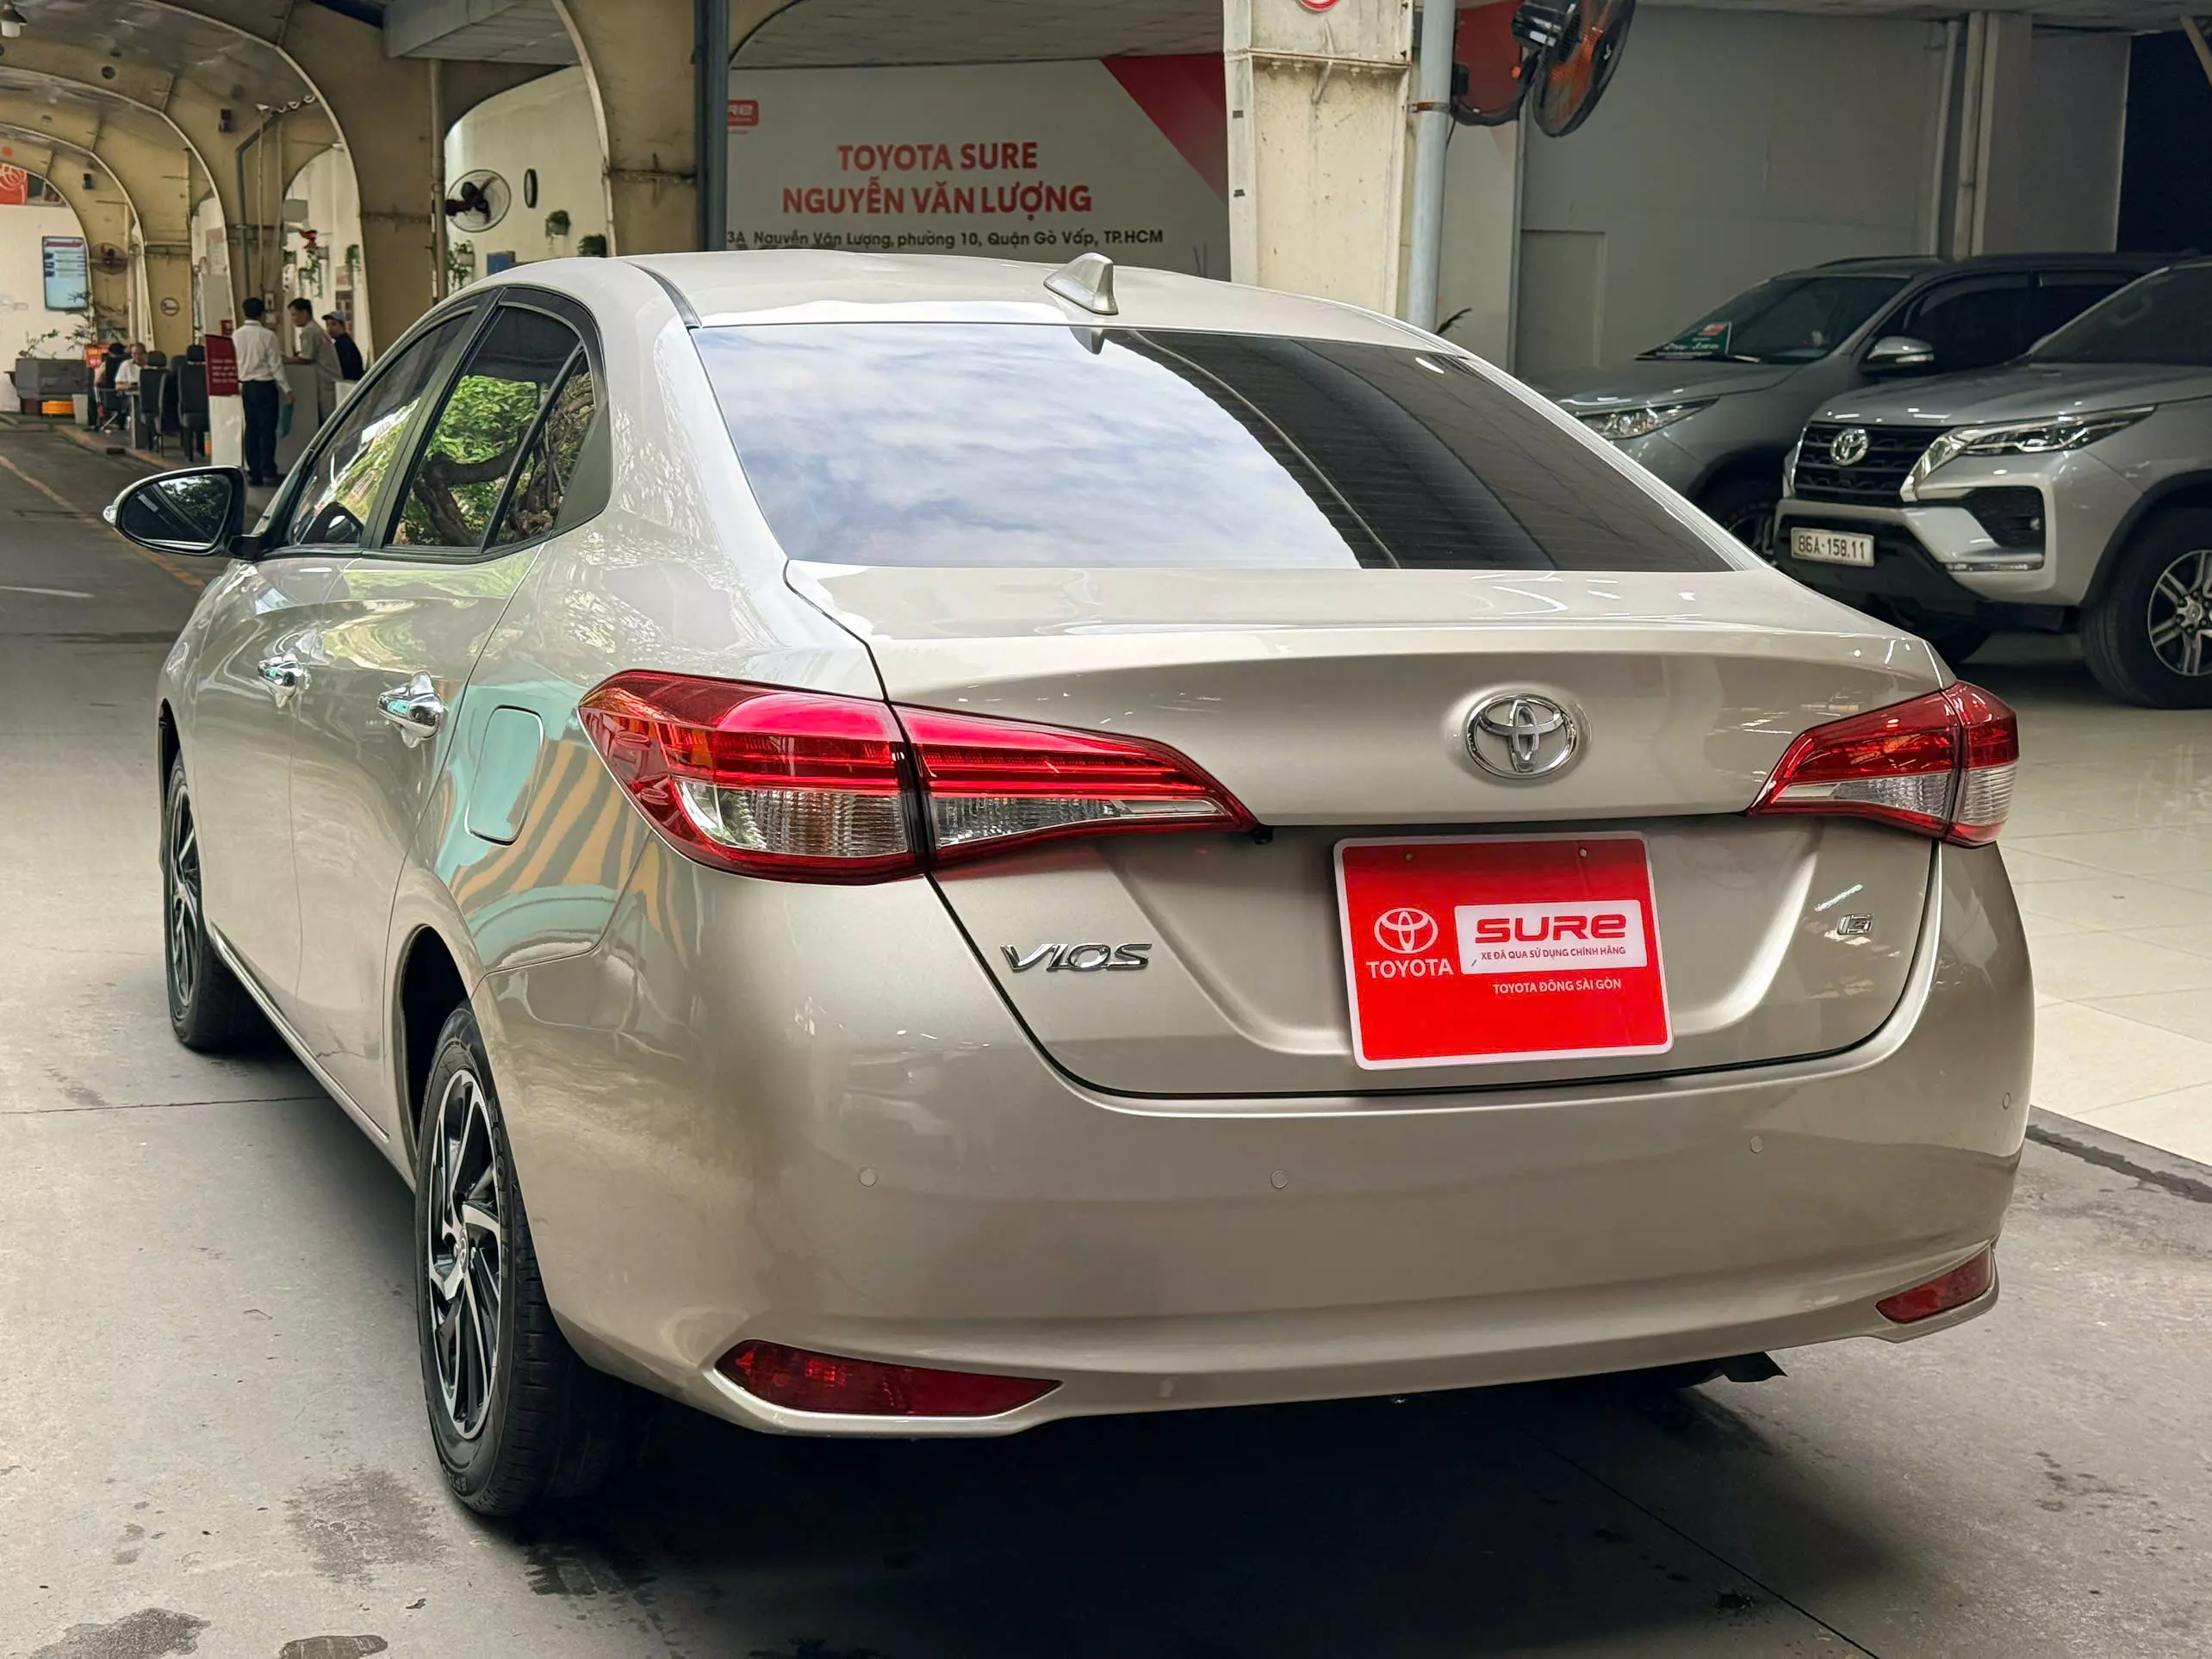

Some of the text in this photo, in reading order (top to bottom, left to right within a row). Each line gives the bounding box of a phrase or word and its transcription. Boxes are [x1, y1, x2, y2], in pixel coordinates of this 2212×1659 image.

[837, 141, 1038, 171] TOYOTA SURE
[782, 176, 1092, 221] NGUYỄN VĂN LƯỢNG
[847, 232, 894, 248] Lượng,
[898, 229, 955, 249] phường
[960, 232, 983, 247] 10,
[988, 231, 1029, 249] Quận
[1034, 229, 1057, 245] Gò
[1062, 227, 1099, 247] Vấp,
[1104, 229, 1164, 245] TP.HCM
[1000, 943, 1153, 973] VIOS
[1481, 951, 1492, 960] XE
[1494, 949, 1507, 960] ĐÃ
[1508, 950, 1527, 960] QUA
[1543, 948, 1569, 960] DỤNG
[1570, 945, 1599, 957] CHÍNH
[1600, 944, 1626, 955] HÃNG
[1365, 957, 1454, 979] TOYOTA
[1492, 976, 1622, 995] TOYOTA ĐÔNG SÀI GÒN
